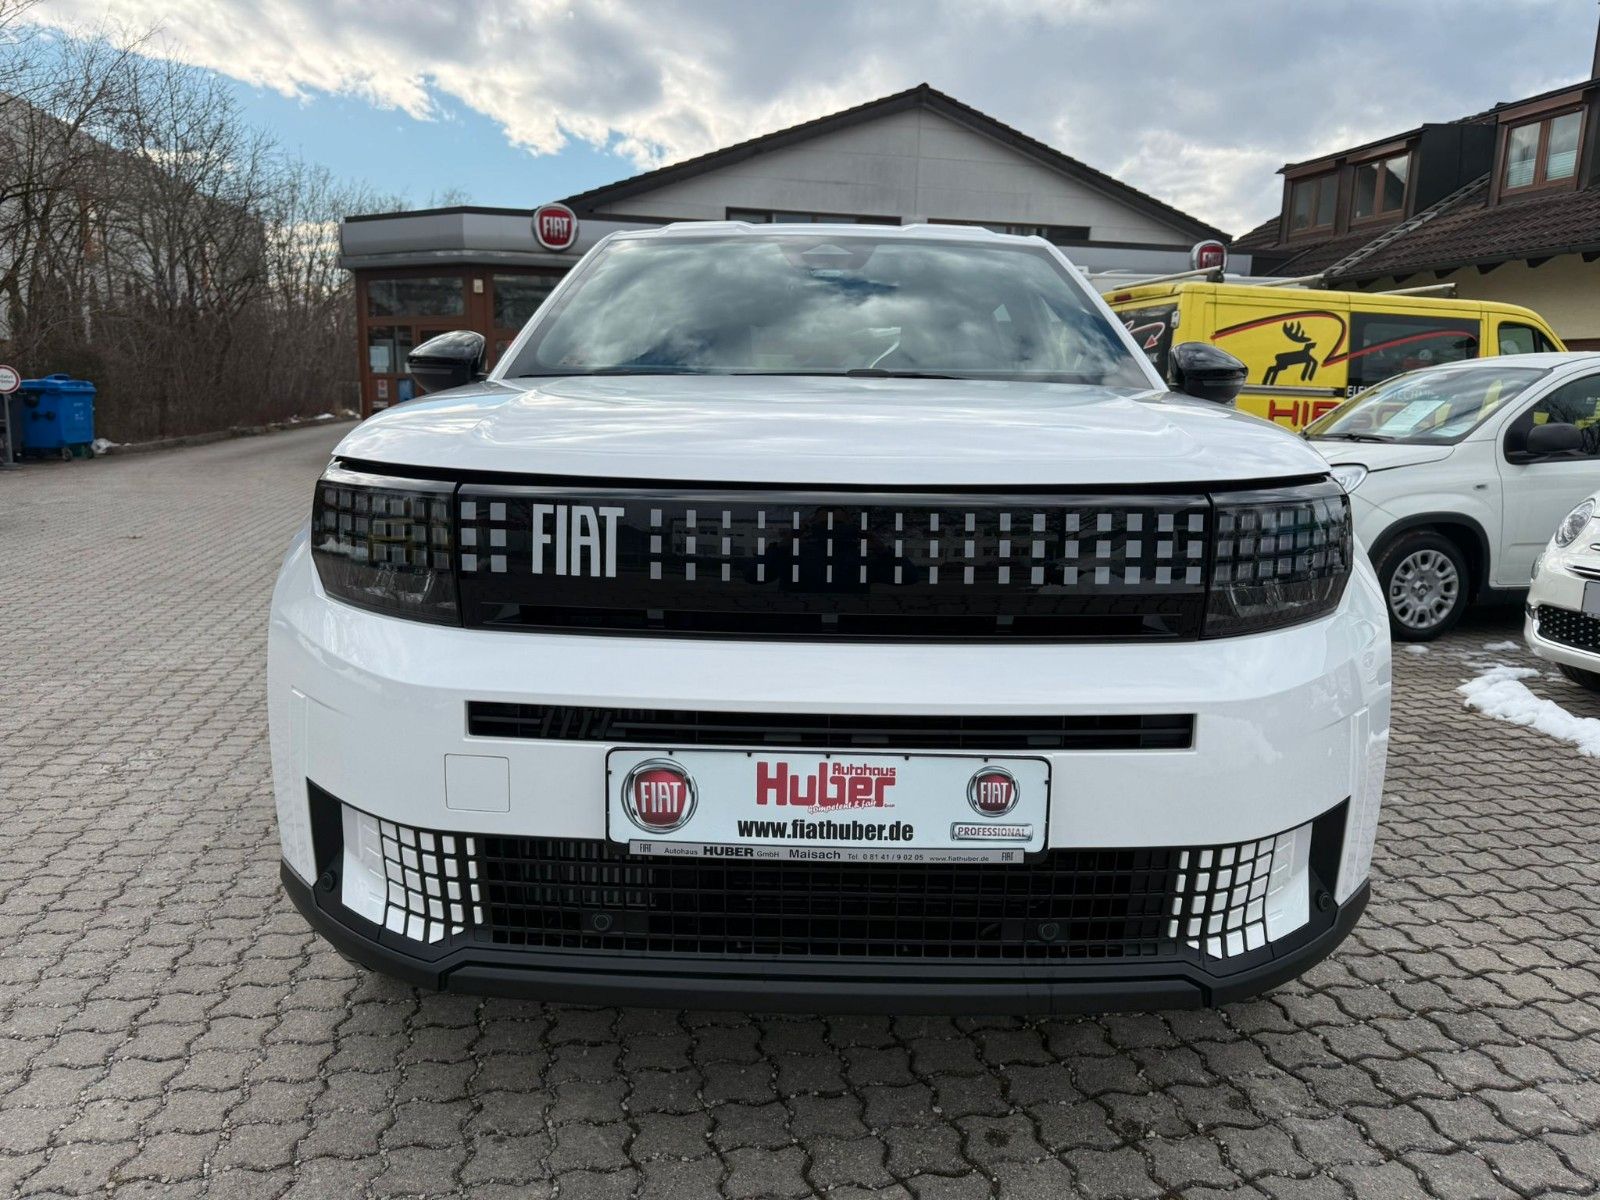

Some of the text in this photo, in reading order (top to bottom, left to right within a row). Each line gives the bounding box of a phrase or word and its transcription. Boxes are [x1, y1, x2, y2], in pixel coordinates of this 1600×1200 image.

[543, 216, 570, 238] FIAT
[532, 503, 625, 577] FIAT
[832, 762, 896, 776] Autohaus
[756, 761, 896, 807] Huber
[980, 781, 1009, 804] FIAT
[640, 781, 681, 813] FIAT
[737, 819, 914, 841] www.fiathuber.de
[957, 826, 1026, 837] PROFESSIONAL
[639, 843, 652, 853] FIAT
[664, 847, 698, 855] Autohaus
[703, 846, 754, 857] HUBER
[789, 849, 841, 860] Maisach
[929, 855, 990, 863] www.fiathuber.de
[1001, 851, 1015, 861] FIAT
